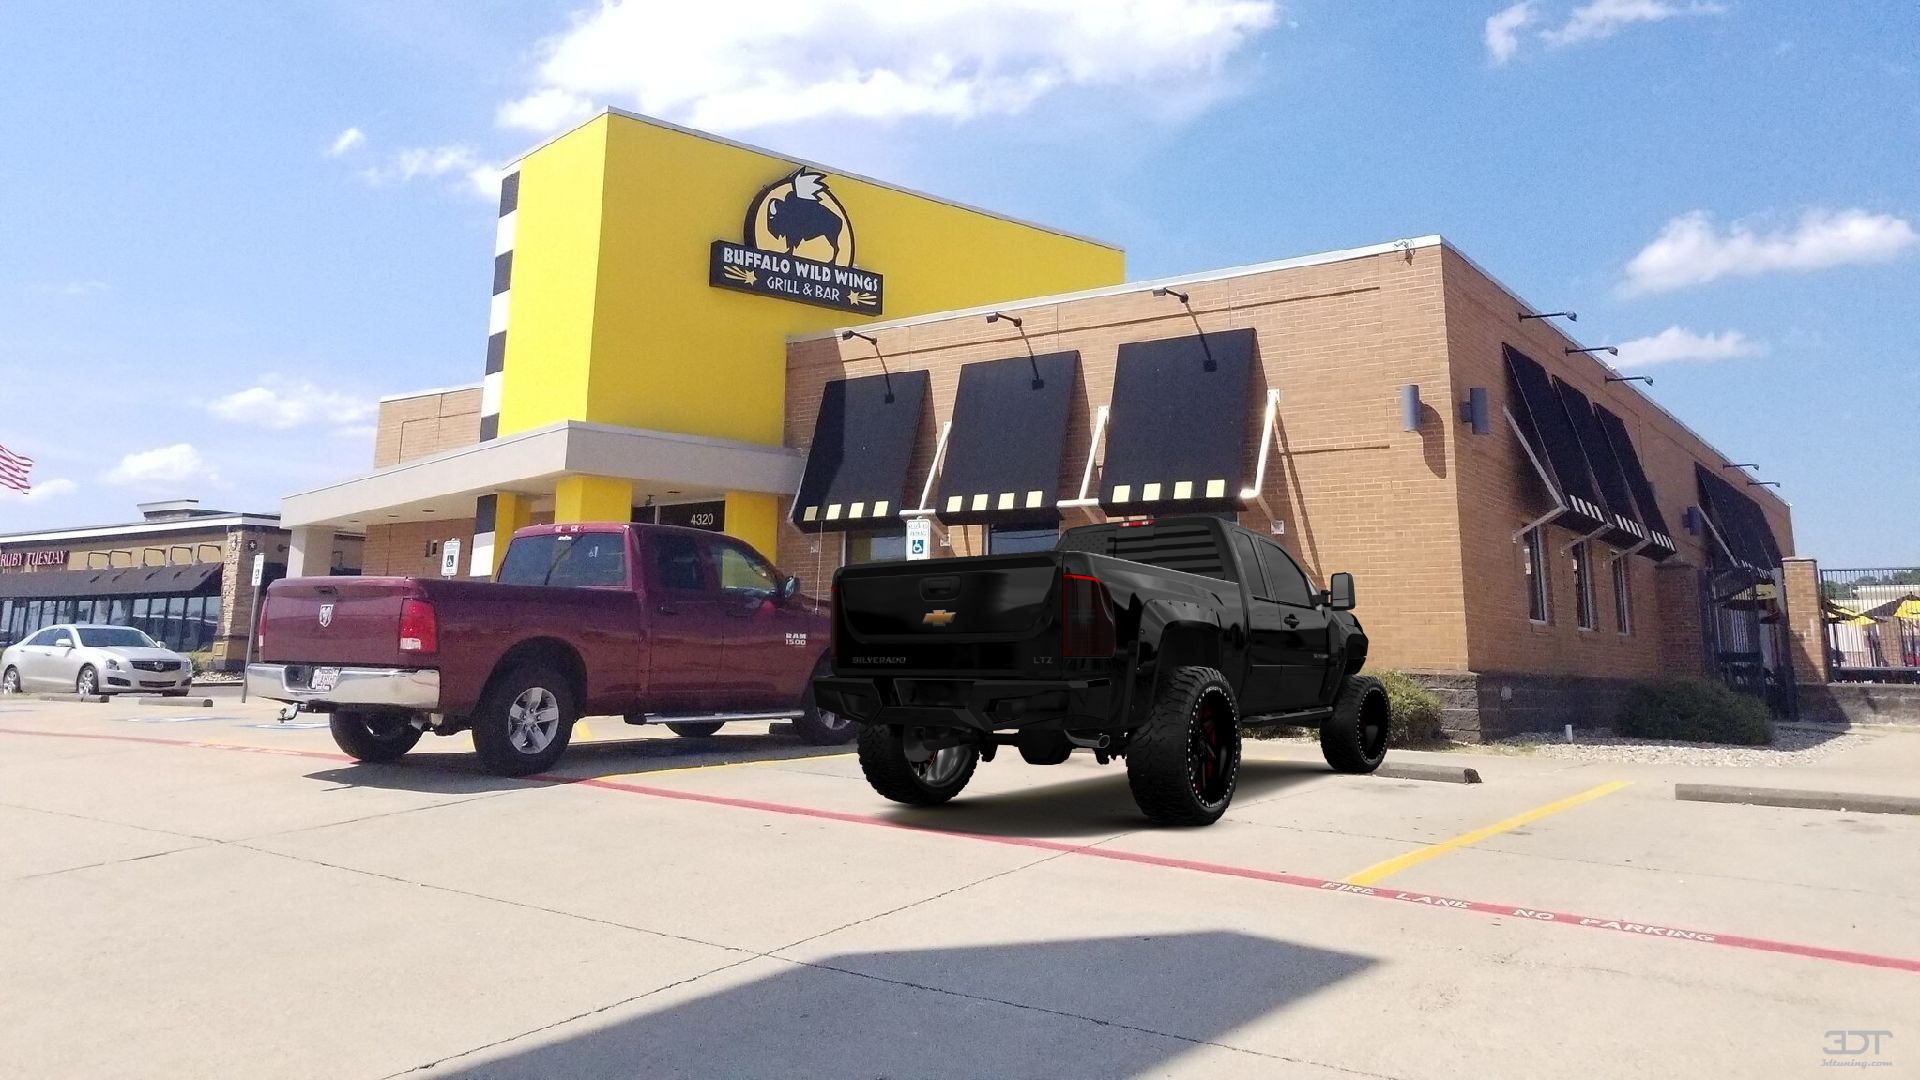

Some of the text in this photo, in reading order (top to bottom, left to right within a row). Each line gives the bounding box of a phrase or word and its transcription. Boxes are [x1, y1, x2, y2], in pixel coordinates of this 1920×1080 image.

[723, 247, 878, 292] BUFFALO WILD WINGS
[766, 276, 840, 302] GRILL & BAR
[690, 513, 714, 526] 4320
[0, 550, 67, 567] RUBY TUESDAY
[852, 656, 907, 664] SILVERADO
[1033, 656, 1053, 664] LTZ
[1320, 881, 1716, 943] FIRE LANE NO PARKING
